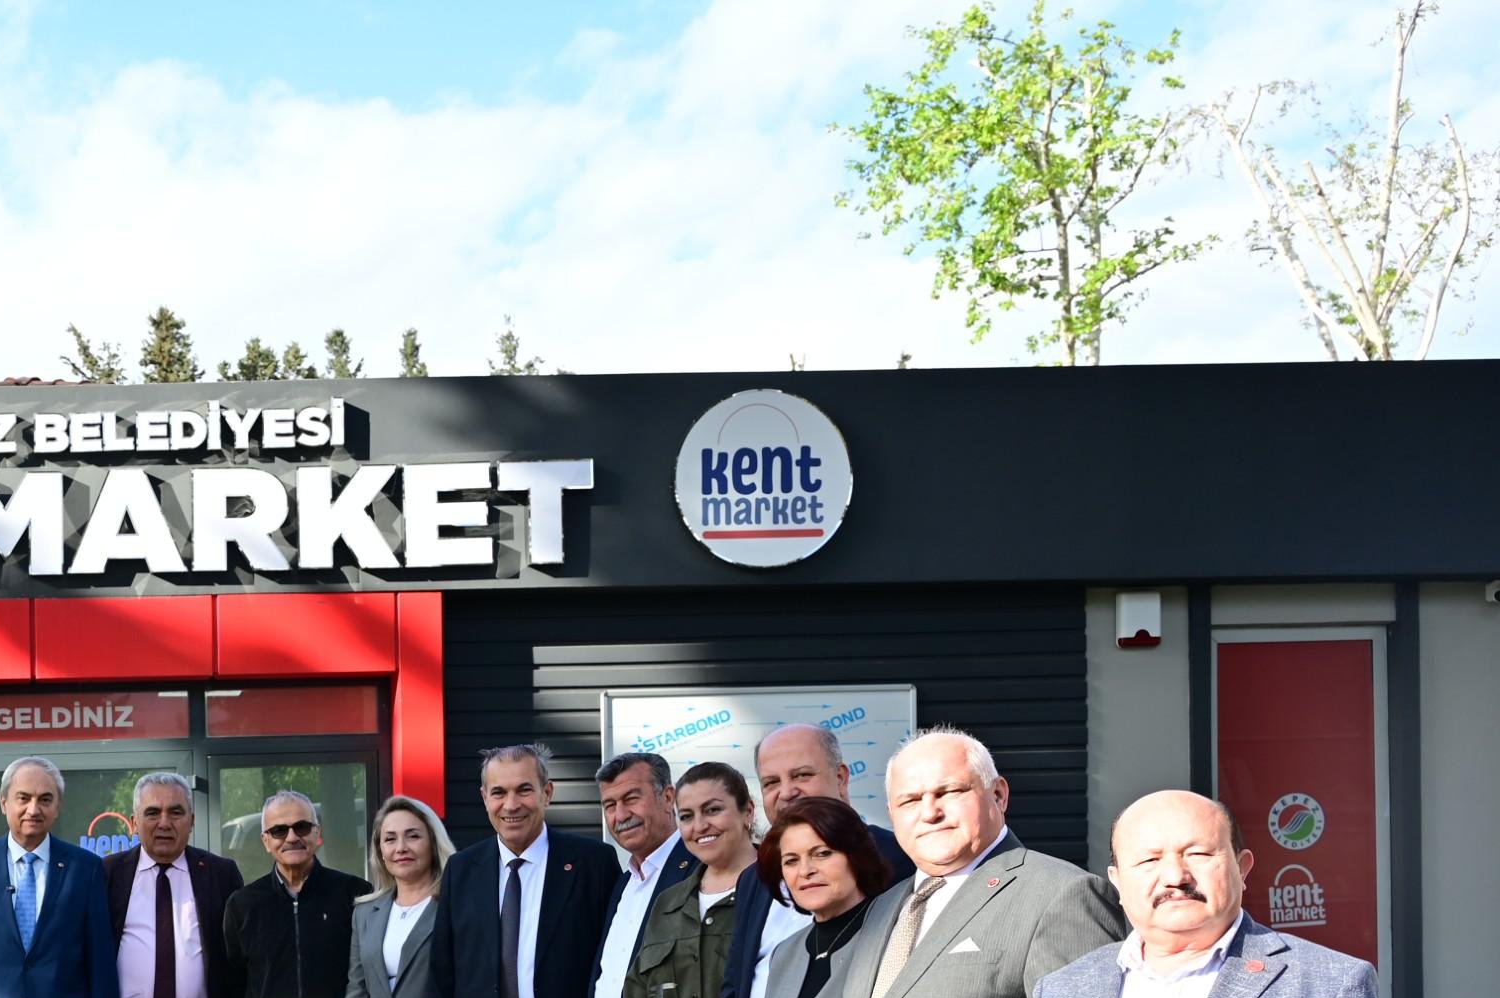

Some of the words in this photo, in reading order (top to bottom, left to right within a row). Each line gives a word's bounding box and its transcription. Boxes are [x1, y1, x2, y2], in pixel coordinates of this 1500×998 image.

[33, 396, 345, 453] BELEDİYESİ
[701, 445, 822, 496] kent
[701, 495, 824, 527] market
[642, 709, 732, 753] STARBOND
[820, 707, 866, 731] BOND
[1272, 795, 1319, 816] KEPEZ
[1268, 882, 1324, 908] kent
[1270, 905, 1327, 923] market
